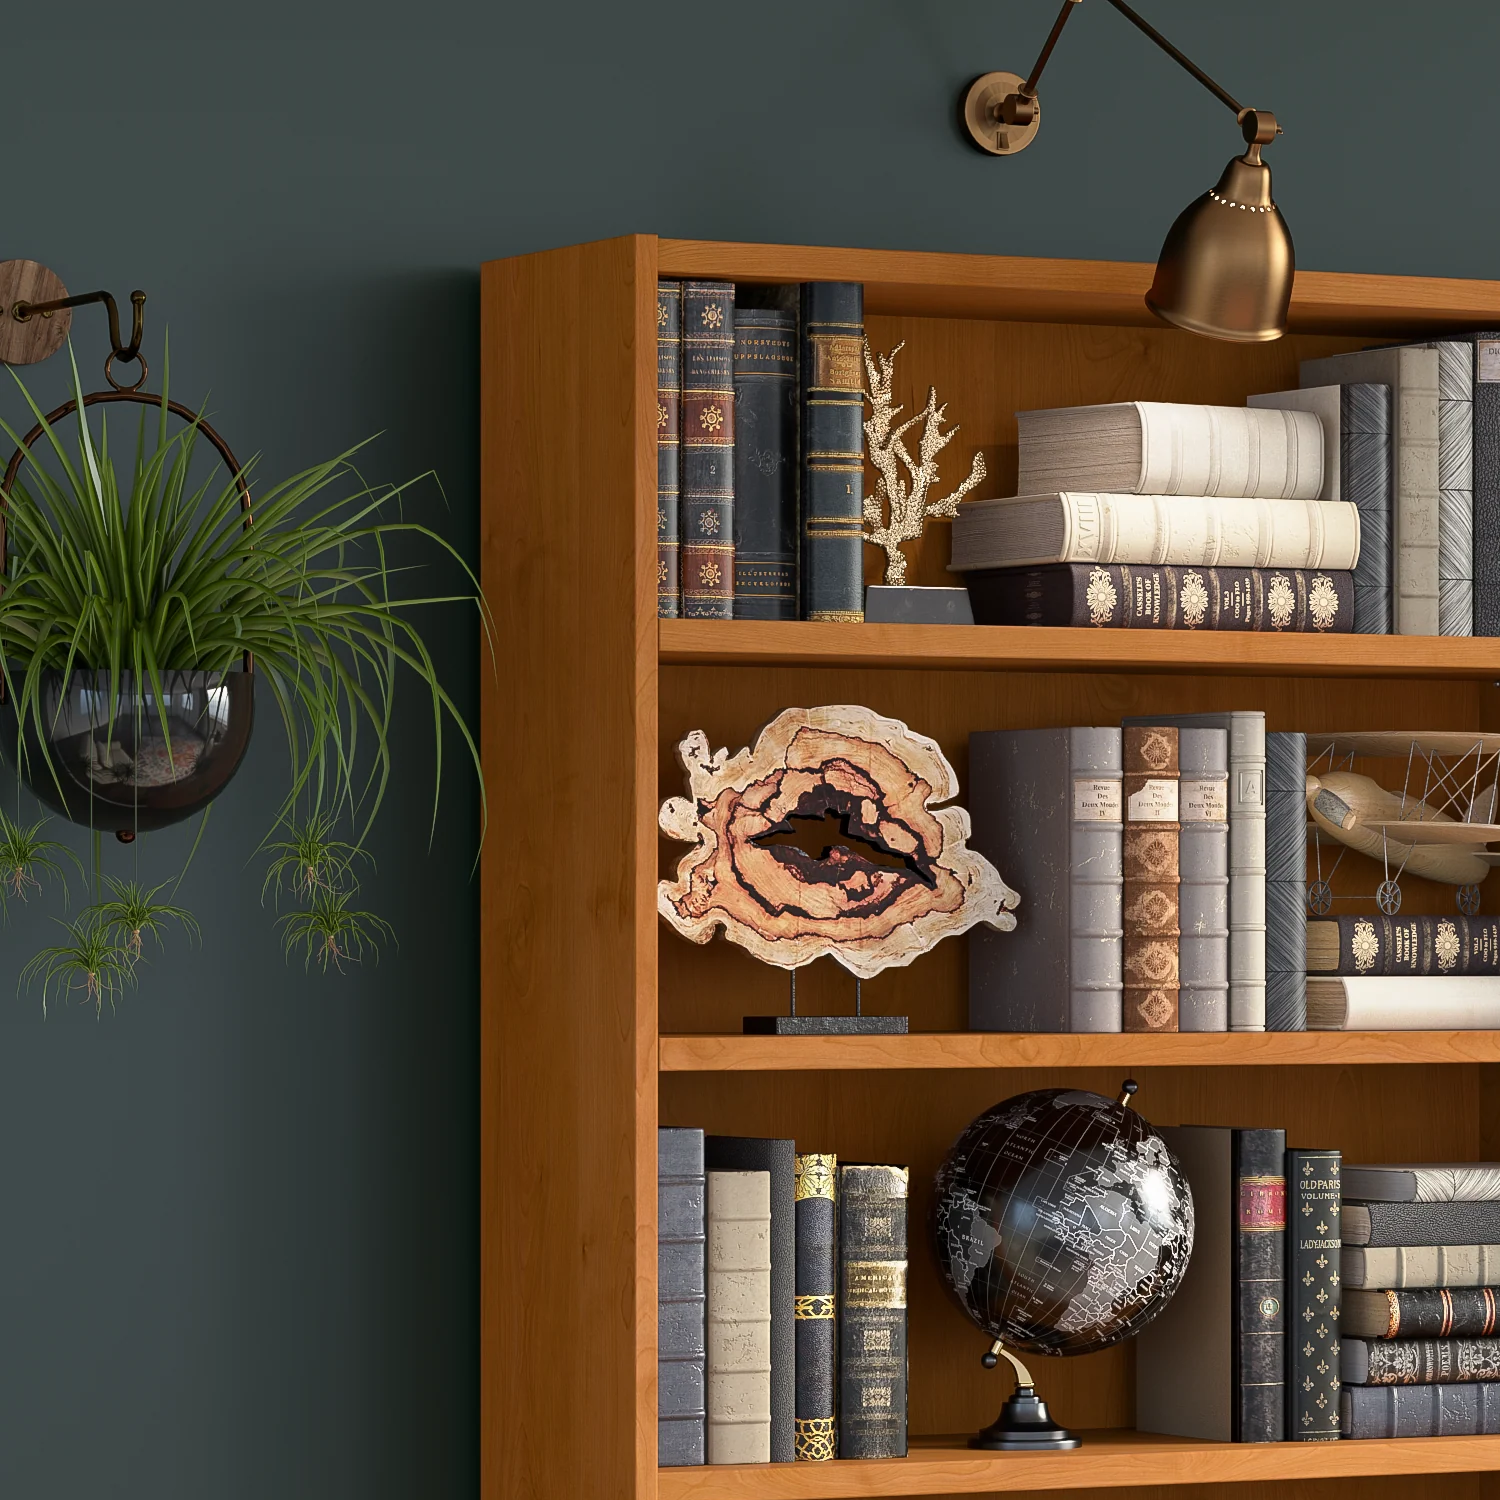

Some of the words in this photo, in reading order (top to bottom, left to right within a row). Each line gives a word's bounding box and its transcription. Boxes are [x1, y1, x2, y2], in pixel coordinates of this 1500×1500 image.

[1144, 578, 1152, 594] OF
[1152, 573, 1161, 624] KNOWLEDGE
[1403, 927, 1410, 942] OF
[1410, 921, 1418, 969] KNOWLEDGE
[1300, 1180, 1317, 1191] OLD
[1317, 1179, 1341, 1190] PARIS
[961, 1234, 985, 1247] BRAZIL
[1441, 1344, 1449, 1377] POEMS
